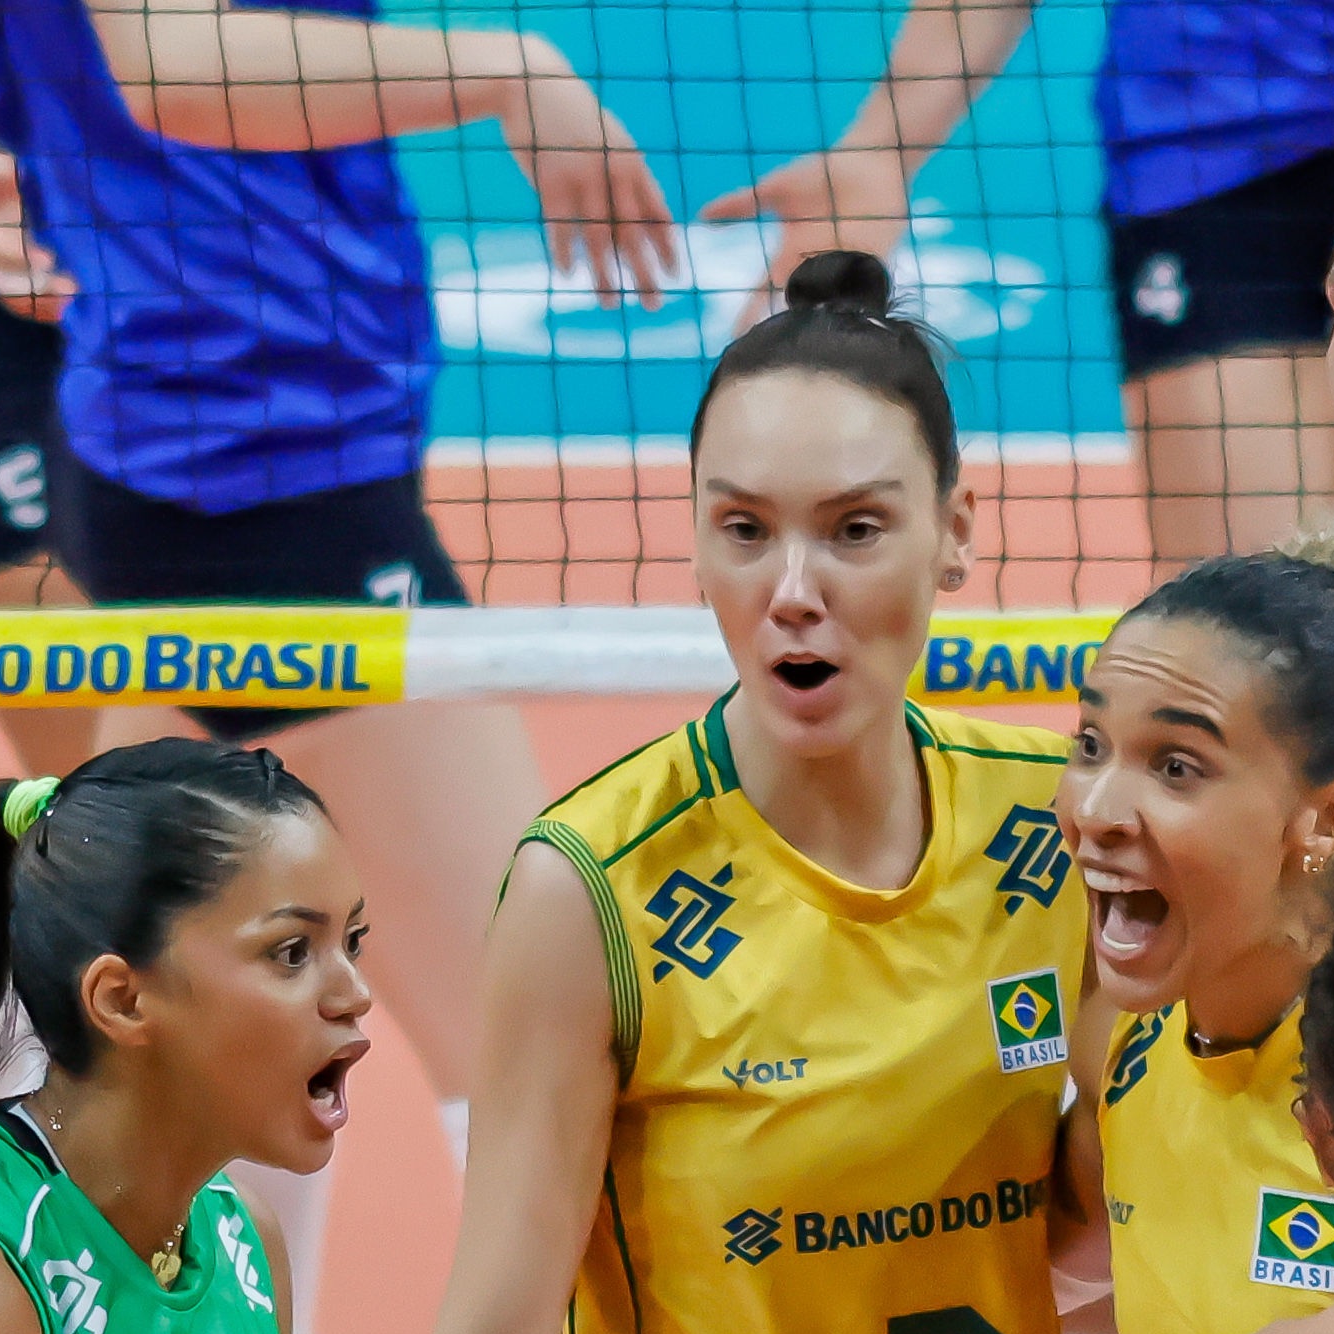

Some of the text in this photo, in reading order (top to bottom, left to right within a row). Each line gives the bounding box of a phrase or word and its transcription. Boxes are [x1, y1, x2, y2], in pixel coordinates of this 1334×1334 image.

[45, 642, 131, 694] DO
[143, 634, 369, 692] BRASIL
[925, 636, 1104, 693] BANC
[722, 1058, 808, 1090] VOLT
[1002, 1039, 1065, 1070] BRASIL
[794, 1201, 935, 1254] BANCO
[941, 1191, 991, 1232] DO
